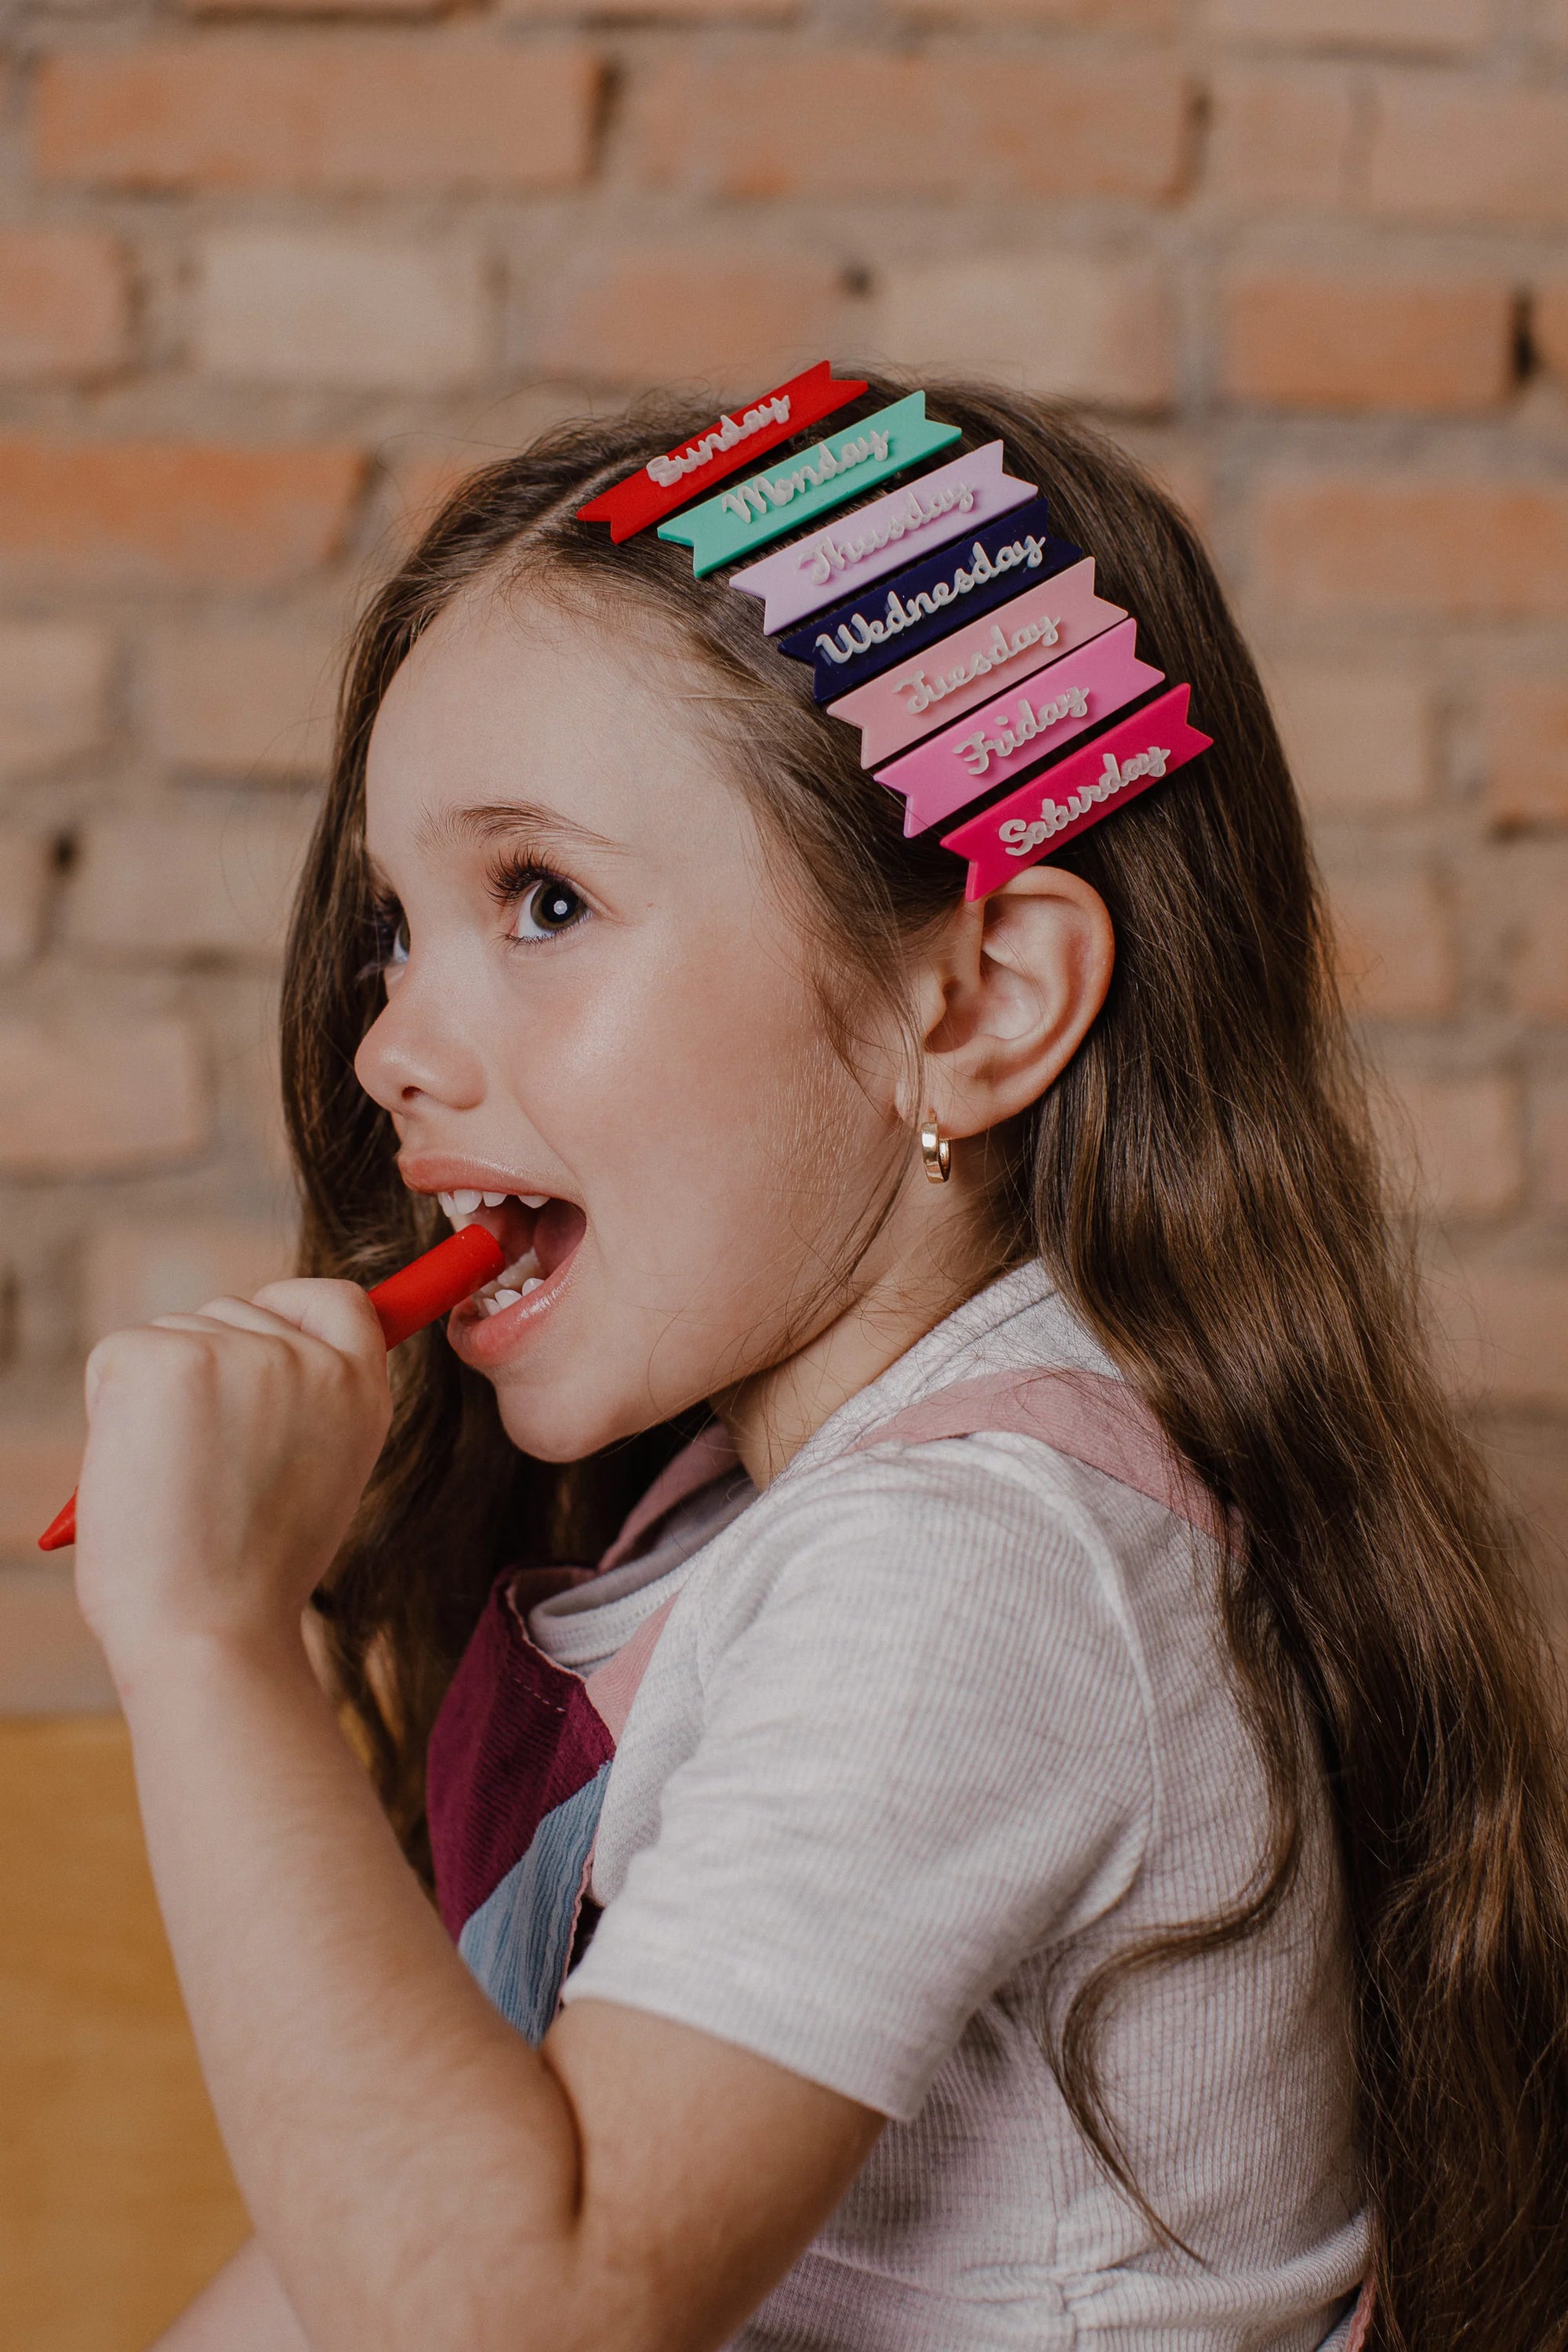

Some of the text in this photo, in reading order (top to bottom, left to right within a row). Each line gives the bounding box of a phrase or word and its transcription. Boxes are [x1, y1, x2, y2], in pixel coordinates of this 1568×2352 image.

[646, 394, 791, 487] Sunday
[721, 429, 890, 523] Monday
[815, 535, 1046, 664] Wednesday
[891, 615, 1061, 714] Tuesday
[952, 685, 1090, 775] Friday
[998, 746, 1171, 856] Saturday
